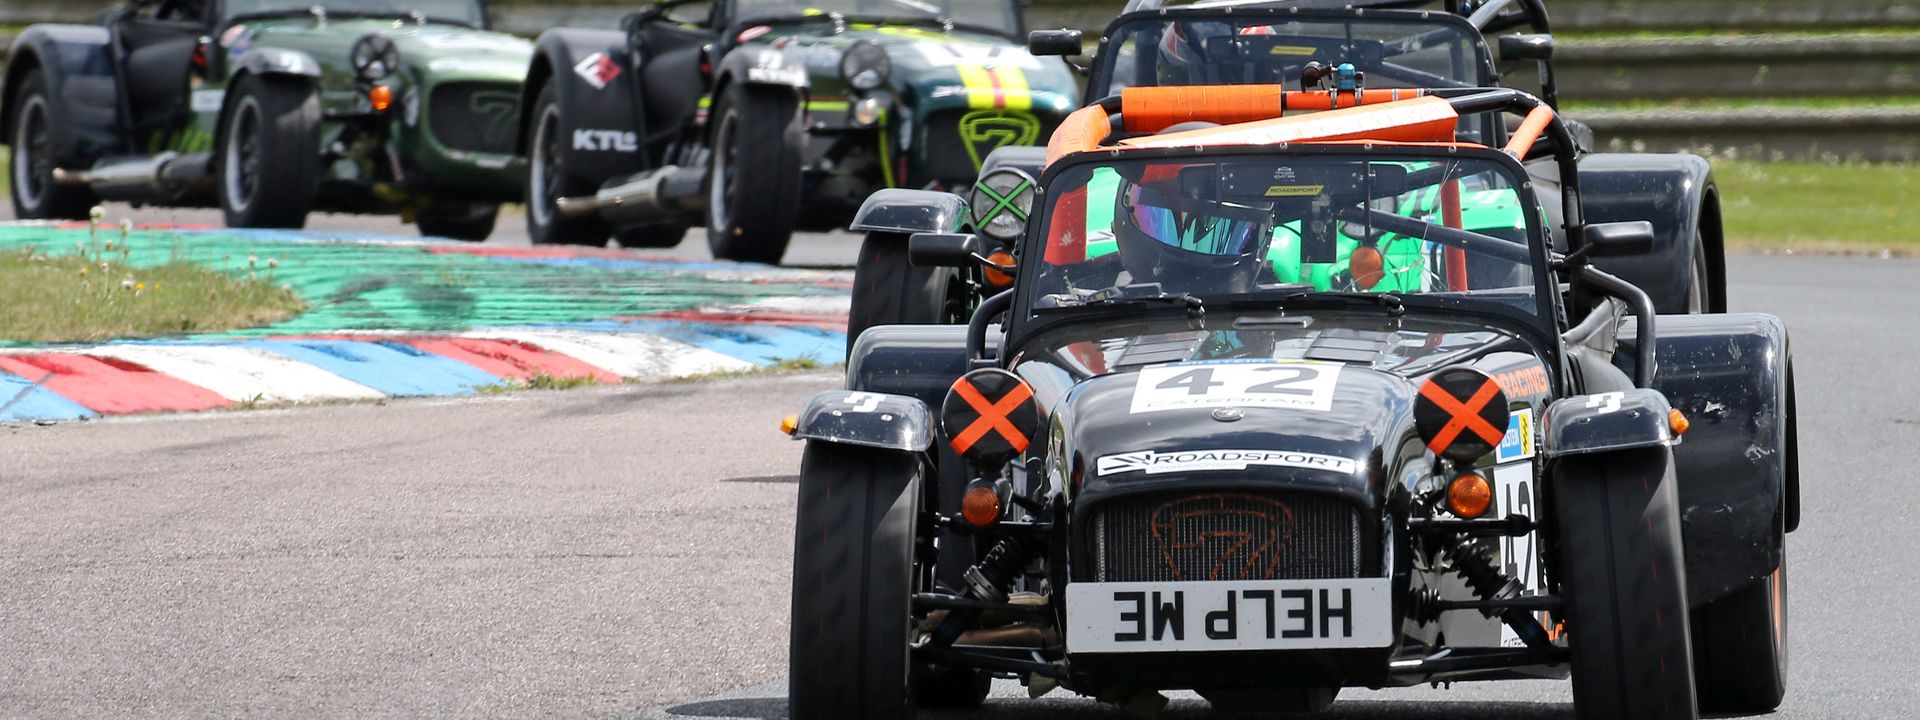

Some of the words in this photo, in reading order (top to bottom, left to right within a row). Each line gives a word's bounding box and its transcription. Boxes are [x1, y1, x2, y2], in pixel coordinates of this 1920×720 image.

[1155, 366, 1320, 396] 42
[1153, 452, 1351, 469] ROADSPORT
[1505, 481, 1535, 597] 42
[1113, 591, 1185, 641] ME
[1205, 588, 1352, 640] HELP
